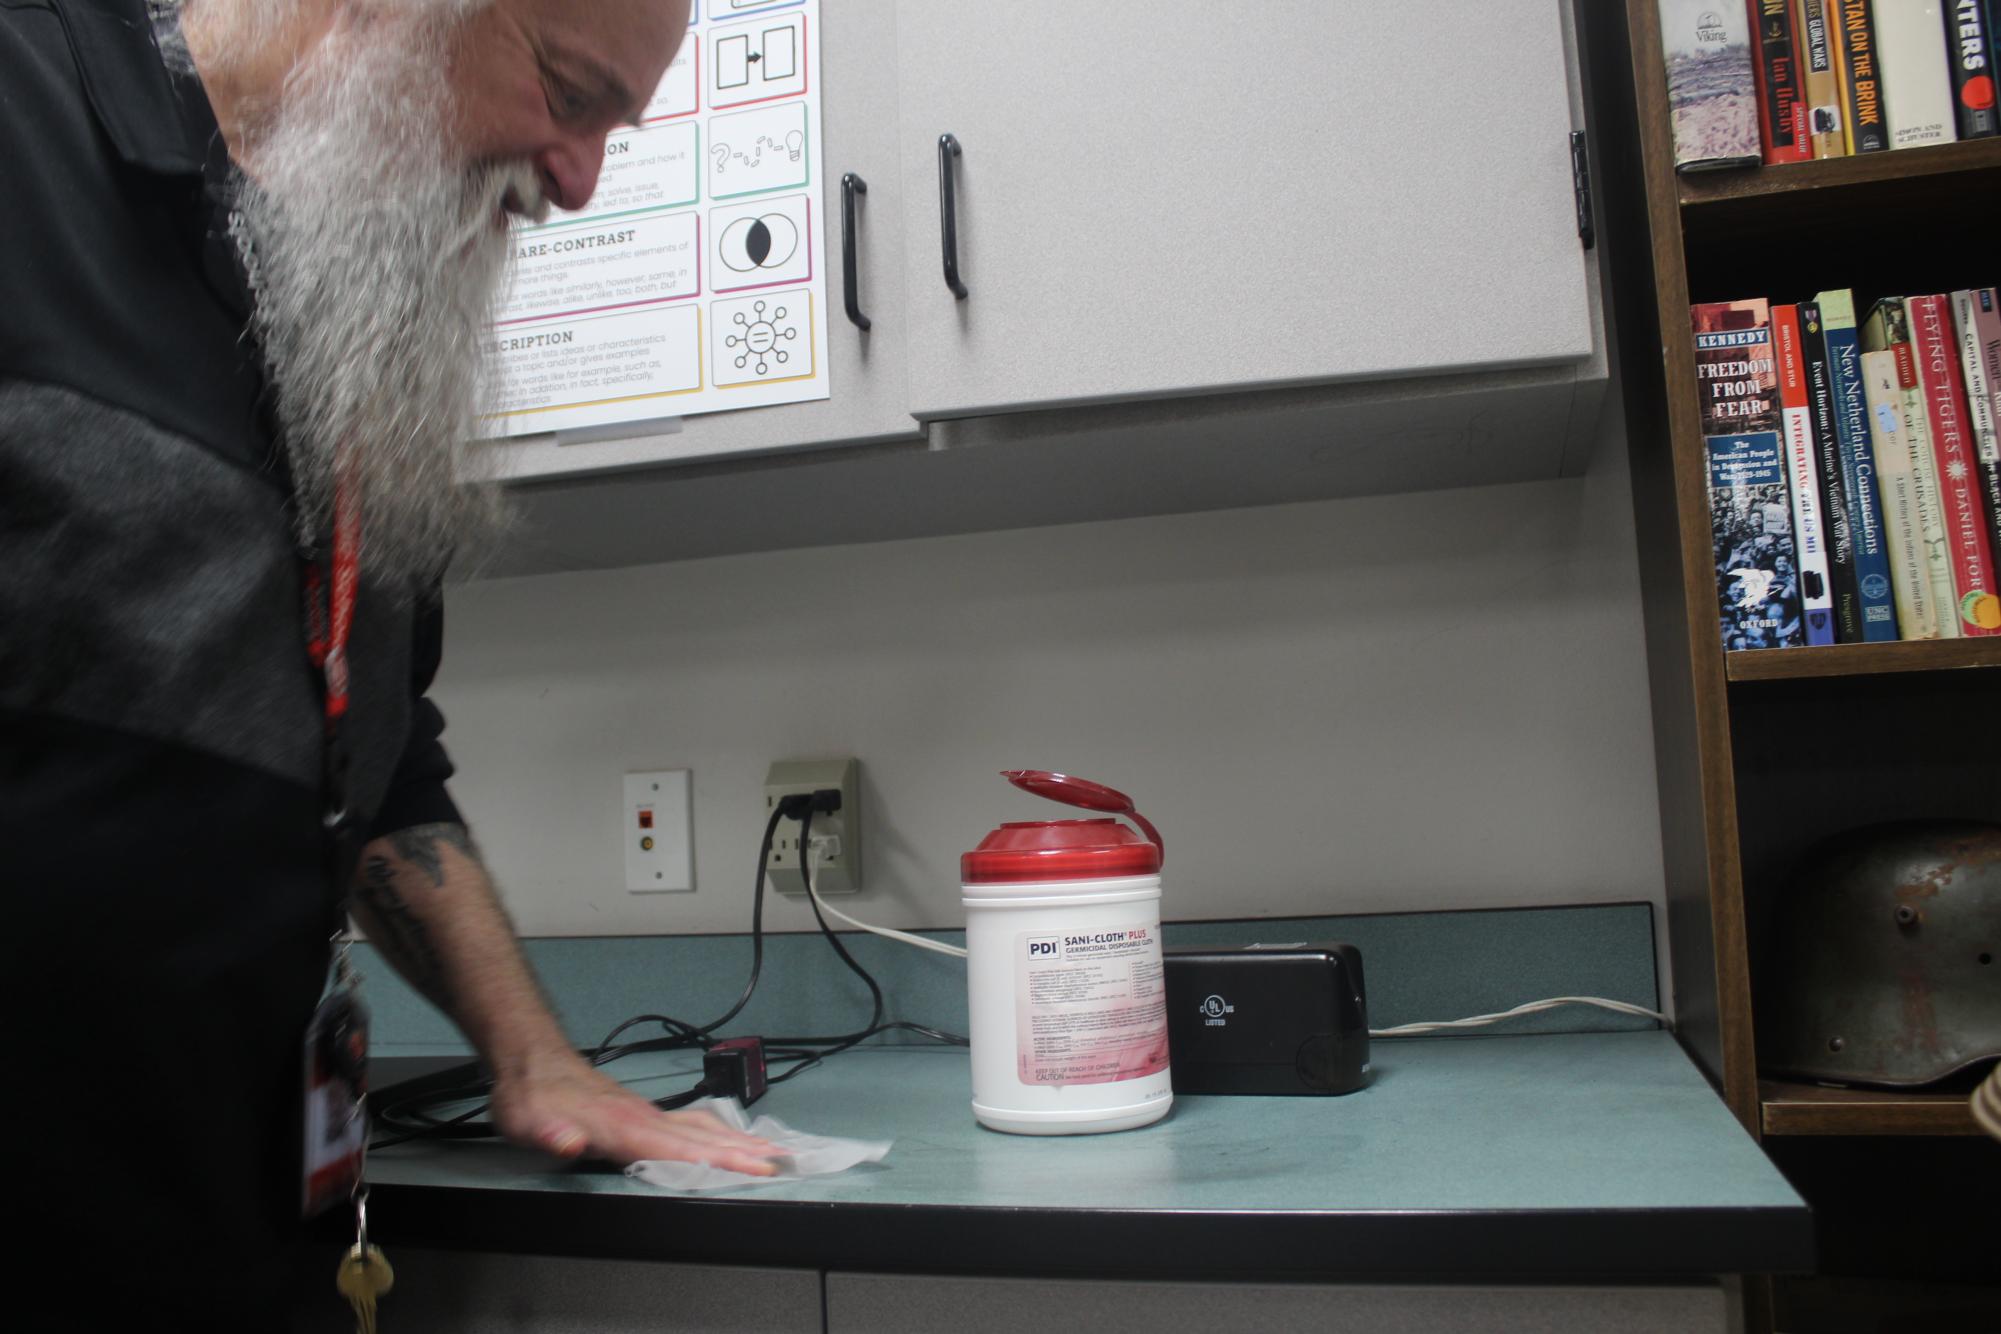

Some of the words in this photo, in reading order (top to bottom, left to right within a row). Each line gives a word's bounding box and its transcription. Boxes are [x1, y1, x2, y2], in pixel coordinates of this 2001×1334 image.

[1696, 30, 1728, 43] Viking
[1809, 19, 1824, 48] GLOBAL
[1850, 33, 1869, 53] ON
[1812, 47, 1827, 69] WARS
[1853, 53, 1873, 78] THE
[1771, 56, 1791, 83] Ian
[1855, 80, 1880, 127] BRINK
[1796, 106, 1806, 131] SPECIAL
[1798, 133, 1808, 153] VALUE
[657, 153, 677, 163] how
[516, 229, 637, 260] ARE-CONTRAST
[597, 249, 633, 264] specific
[634, 244, 677, 257] elements
[678, 241, 690, 251] of
[521, 287, 548, 300] words
[550, 285, 564, 296] like
[660, 280, 677, 291] but
[598, 333, 667, 350] characteristics
[1698, 330, 1767, 348] KENNEDY
[1781, 324, 1792, 353] BRISTOL
[522, 361, 545, 373] topic
[579, 352, 604, 367] gives
[605, 347, 651, 362] examples
[1697, 358, 1774, 379] FREEDOM
[1785, 353, 1794, 371] AND
[1839, 344, 1857, 378] New
[521, 374, 549, 386] words
[550, 371, 565, 382] like
[566, 369, 579, 380] for
[624, 360, 647, 372] such
[1812, 360, 1825, 389] Event
[1921, 303, 1947, 372] FLYING
[1934, 385, 1962, 453] TIGERS
[1712, 379, 1762, 398] FROM
[1715, 400, 1763, 418] FEAR
[1816, 391, 1831, 431] Horizon:
[1965, 333, 1978, 372] CAPITAL
[1973, 374, 1983, 395] AND
[1989, 474, 2001, 506] BLACK
[1845, 379, 1866, 462] Netherland
[1734, 441, 1750, 449] The
[1822, 432, 1831, 441] A
[1712, 451, 1749, 461] American
[1749, 448, 1775, 460] People
[1762, 458, 1778, 467] and
[1828, 481, 1842, 519] Vietnam
[1855, 463, 1878, 555] Connections
[1912, 467, 1930, 533] CRUSADES
[1955, 488, 1979, 548] DANIEL
[1833, 519, 1844, 540] War
[1835, 537, 1848, 566] Story
[1739, 618, 1780, 629] OXFORD
[1128, 929, 1147, 940] PLUS
[1030, 942, 1057, 955] PDI
[1065, 944, 1106, 954] GERMICIDAL
[1108, 940, 1141, 950] DISPOSABLE
[1035, 1073, 1065, 1081] CAUTION
